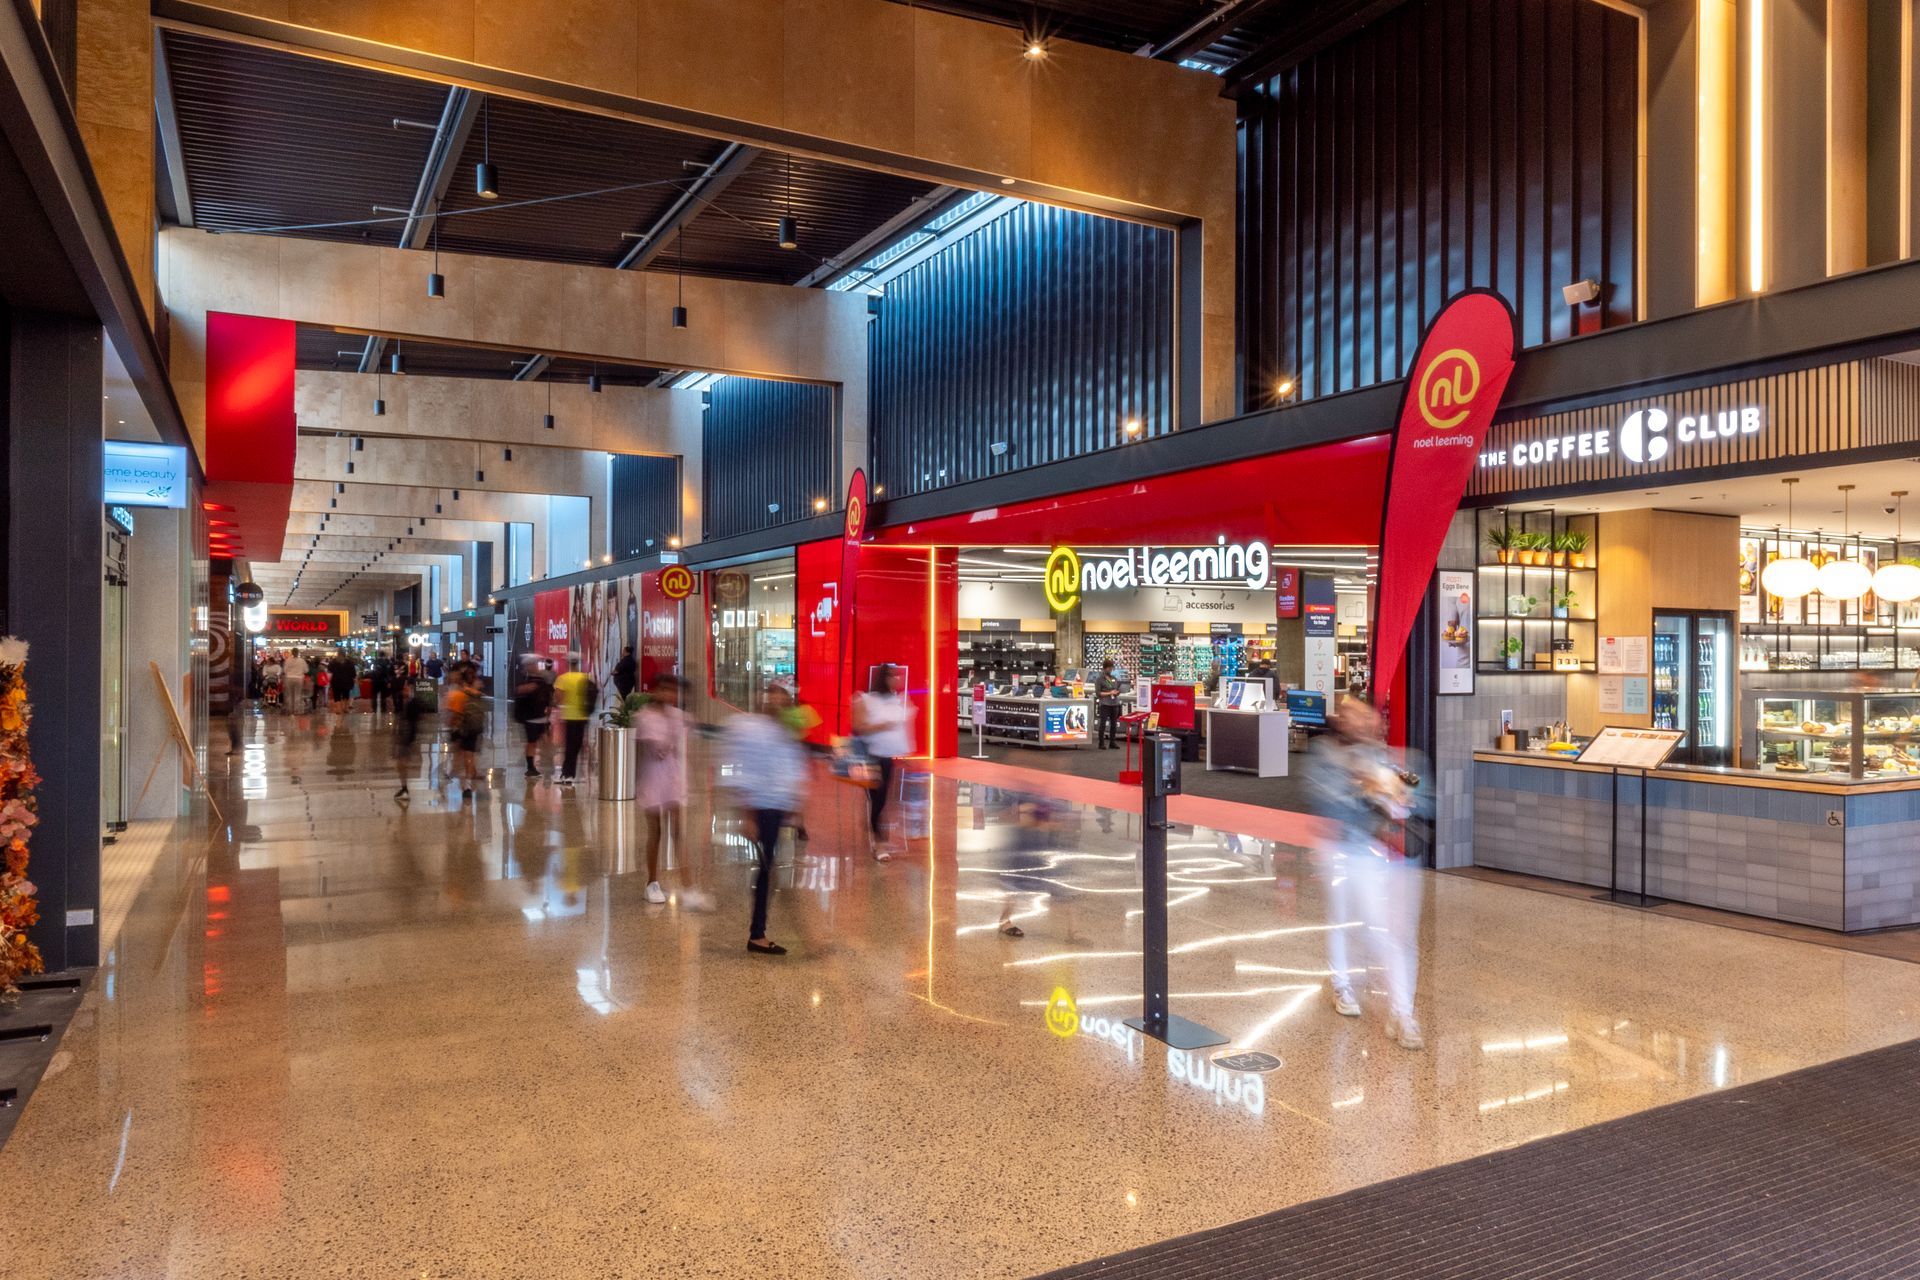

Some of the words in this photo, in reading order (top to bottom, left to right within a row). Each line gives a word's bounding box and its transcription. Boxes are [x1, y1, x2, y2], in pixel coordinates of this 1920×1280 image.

[1413, 436, 1434, 448] noel
[1435, 434, 1474, 448] leeming
[1479, 452, 1507, 468] THE
[1512, 430, 1610, 466] COFFEE
[1677, 407, 1761, 442] CLUB
[134, 468, 177, 481] beauty
[1081, 548, 1138, 592] noel
[1142, 535, 1269, 590] leeming
[1442, 582, 1455, 591] Eggs
[1185, 601, 1235, 611] accessories
[276, 620, 328, 631] WORLD
[548, 618, 568, 640] Postie
[643, 611, 675, 638] Postie
[643, 645, 660, 657] COMING
[660, 645, 675, 657] SOON
